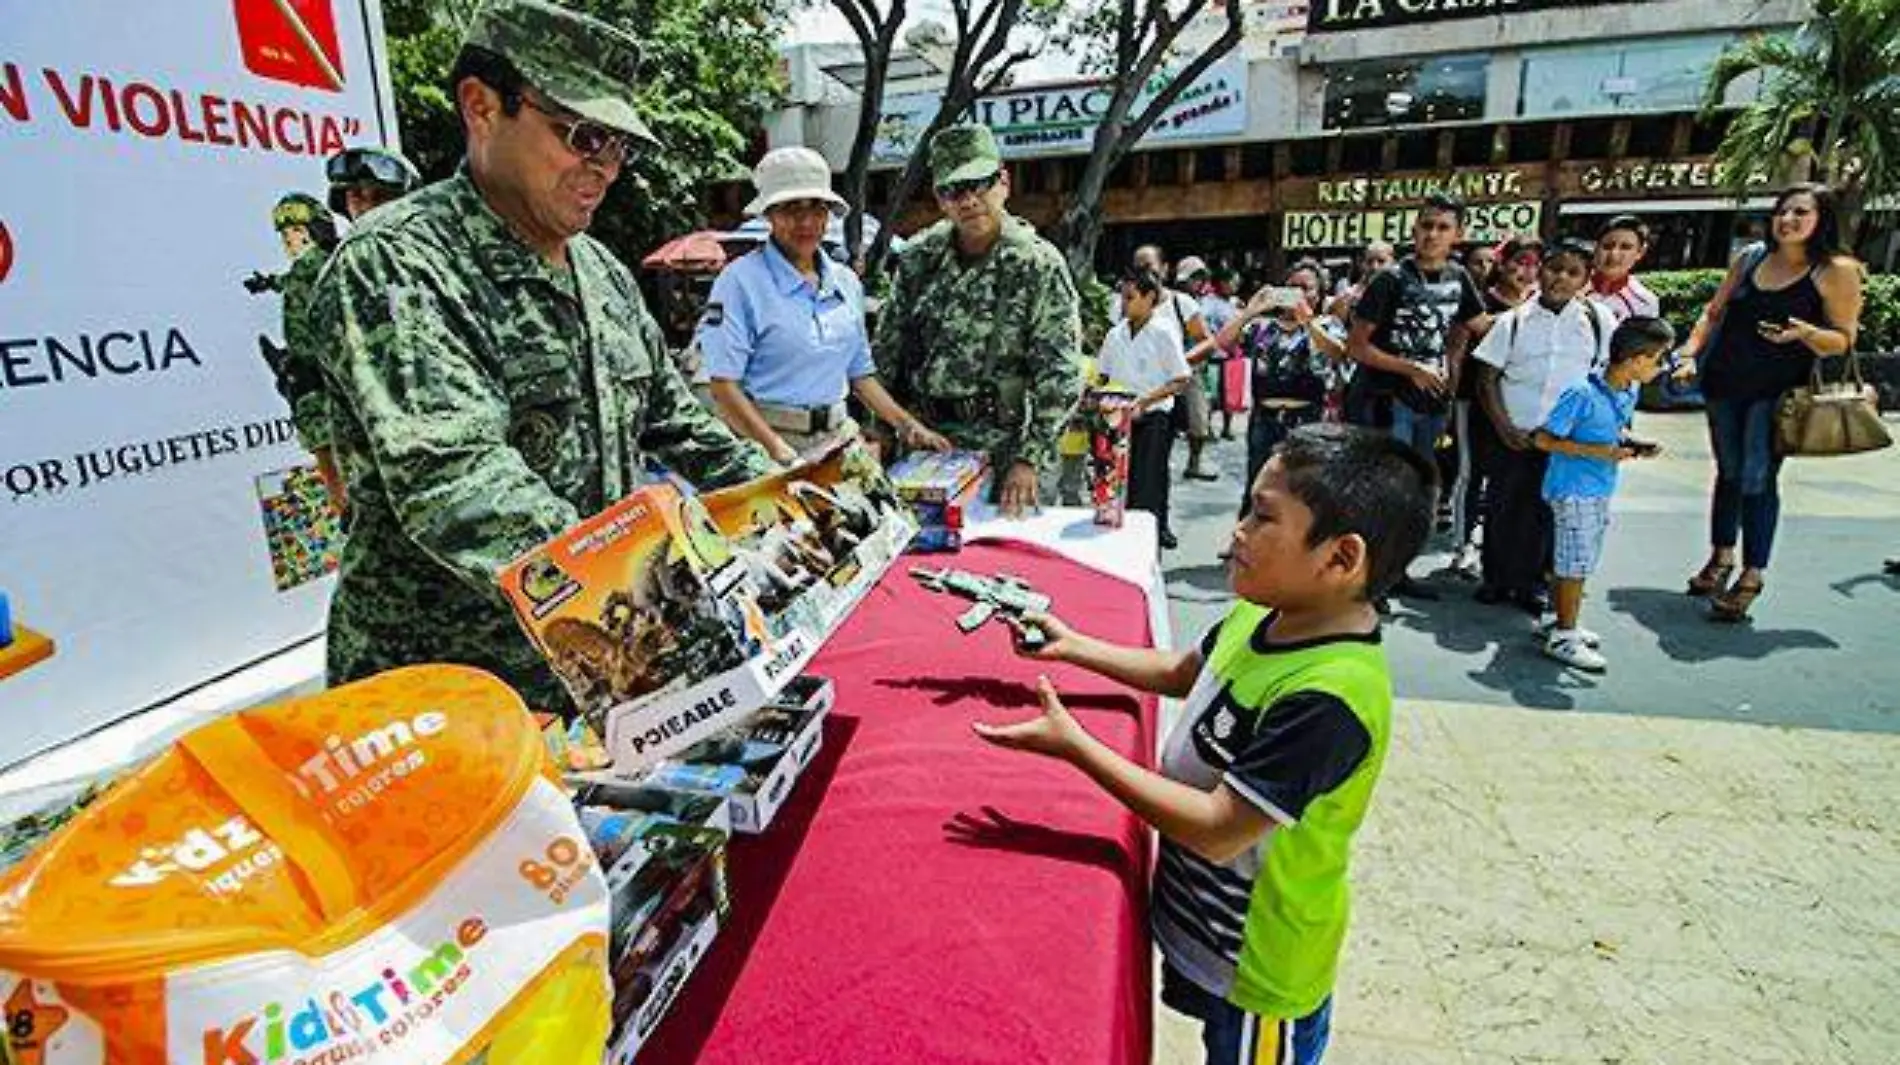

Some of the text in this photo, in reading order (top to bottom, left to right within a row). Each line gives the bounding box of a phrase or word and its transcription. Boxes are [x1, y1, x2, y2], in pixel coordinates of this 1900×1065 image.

[1008, 89, 1115, 123] PIAC
[1581, 161, 1769, 191] CAFETERA
[1287, 211, 1374, 247] HOTEL
[1382, 206, 1414, 243] EL
[0, 328, 202, 387] ENCIA
[0, 418, 295, 495] OR JUGUETES DID
[518, 836, 579, 891] 80
